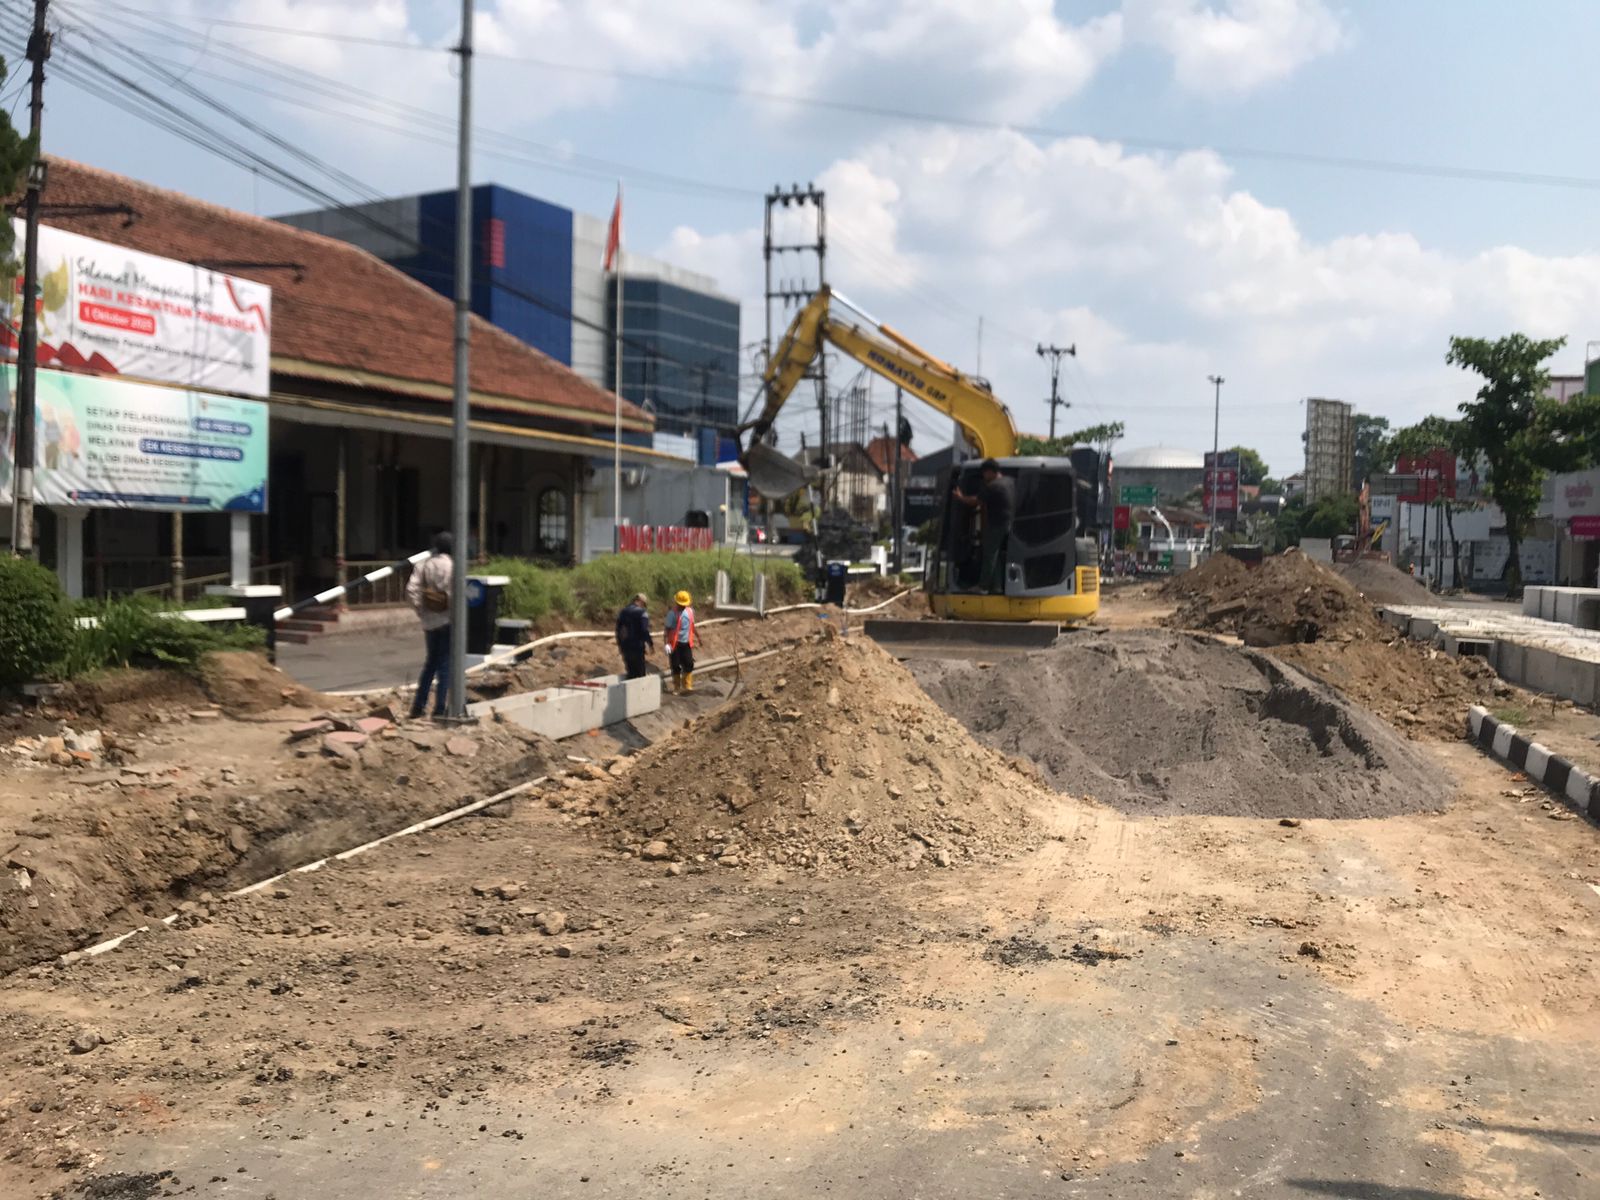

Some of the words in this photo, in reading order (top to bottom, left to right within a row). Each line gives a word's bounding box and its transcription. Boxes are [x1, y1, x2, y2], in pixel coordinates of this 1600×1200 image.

[77, 257, 129, 286] Selamat
[79, 282, 113, 301] HARI
[84, 305, 90, 319] 1
[91, 306, 130, 326] Oktober
[867, 350, 925, 389] KOMATSU
